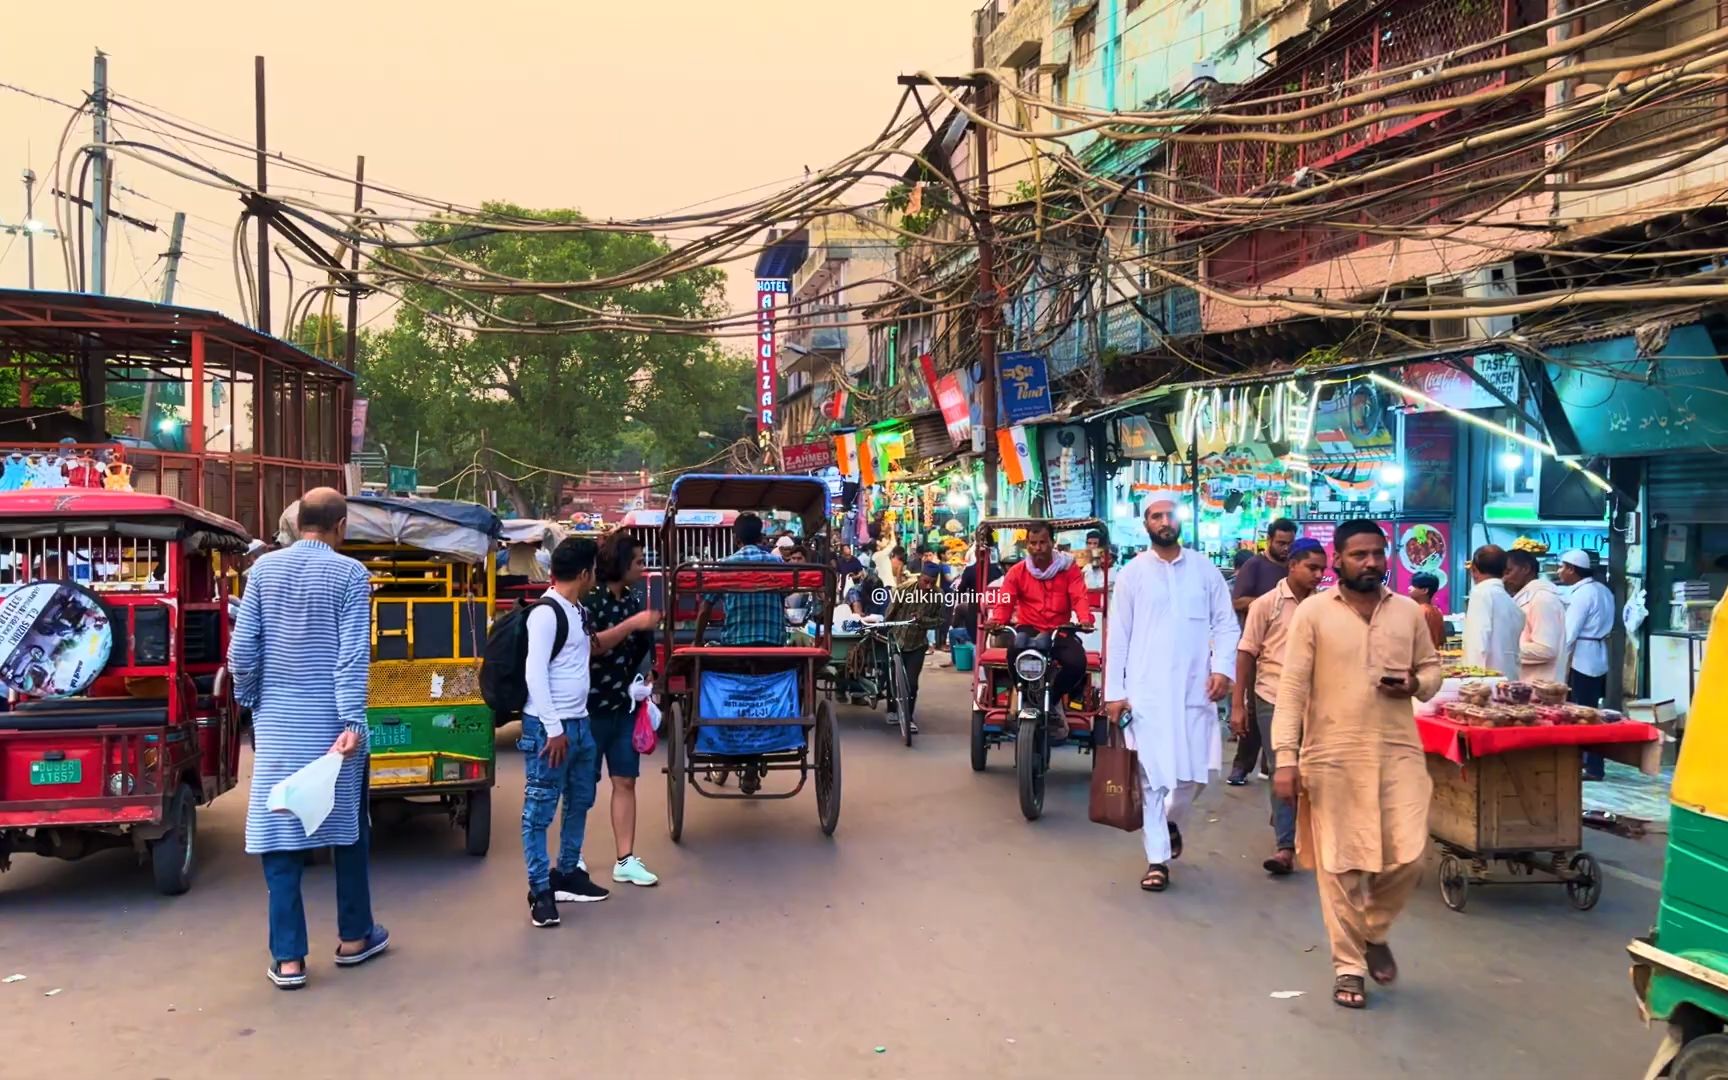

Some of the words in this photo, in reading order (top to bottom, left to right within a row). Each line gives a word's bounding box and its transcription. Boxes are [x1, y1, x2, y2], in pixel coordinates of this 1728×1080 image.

[757, 280, 788, 292] HOTEL
[1480, 355, 1511, 371] TASTY
[8, 620, 31, 646] SUZUKI
